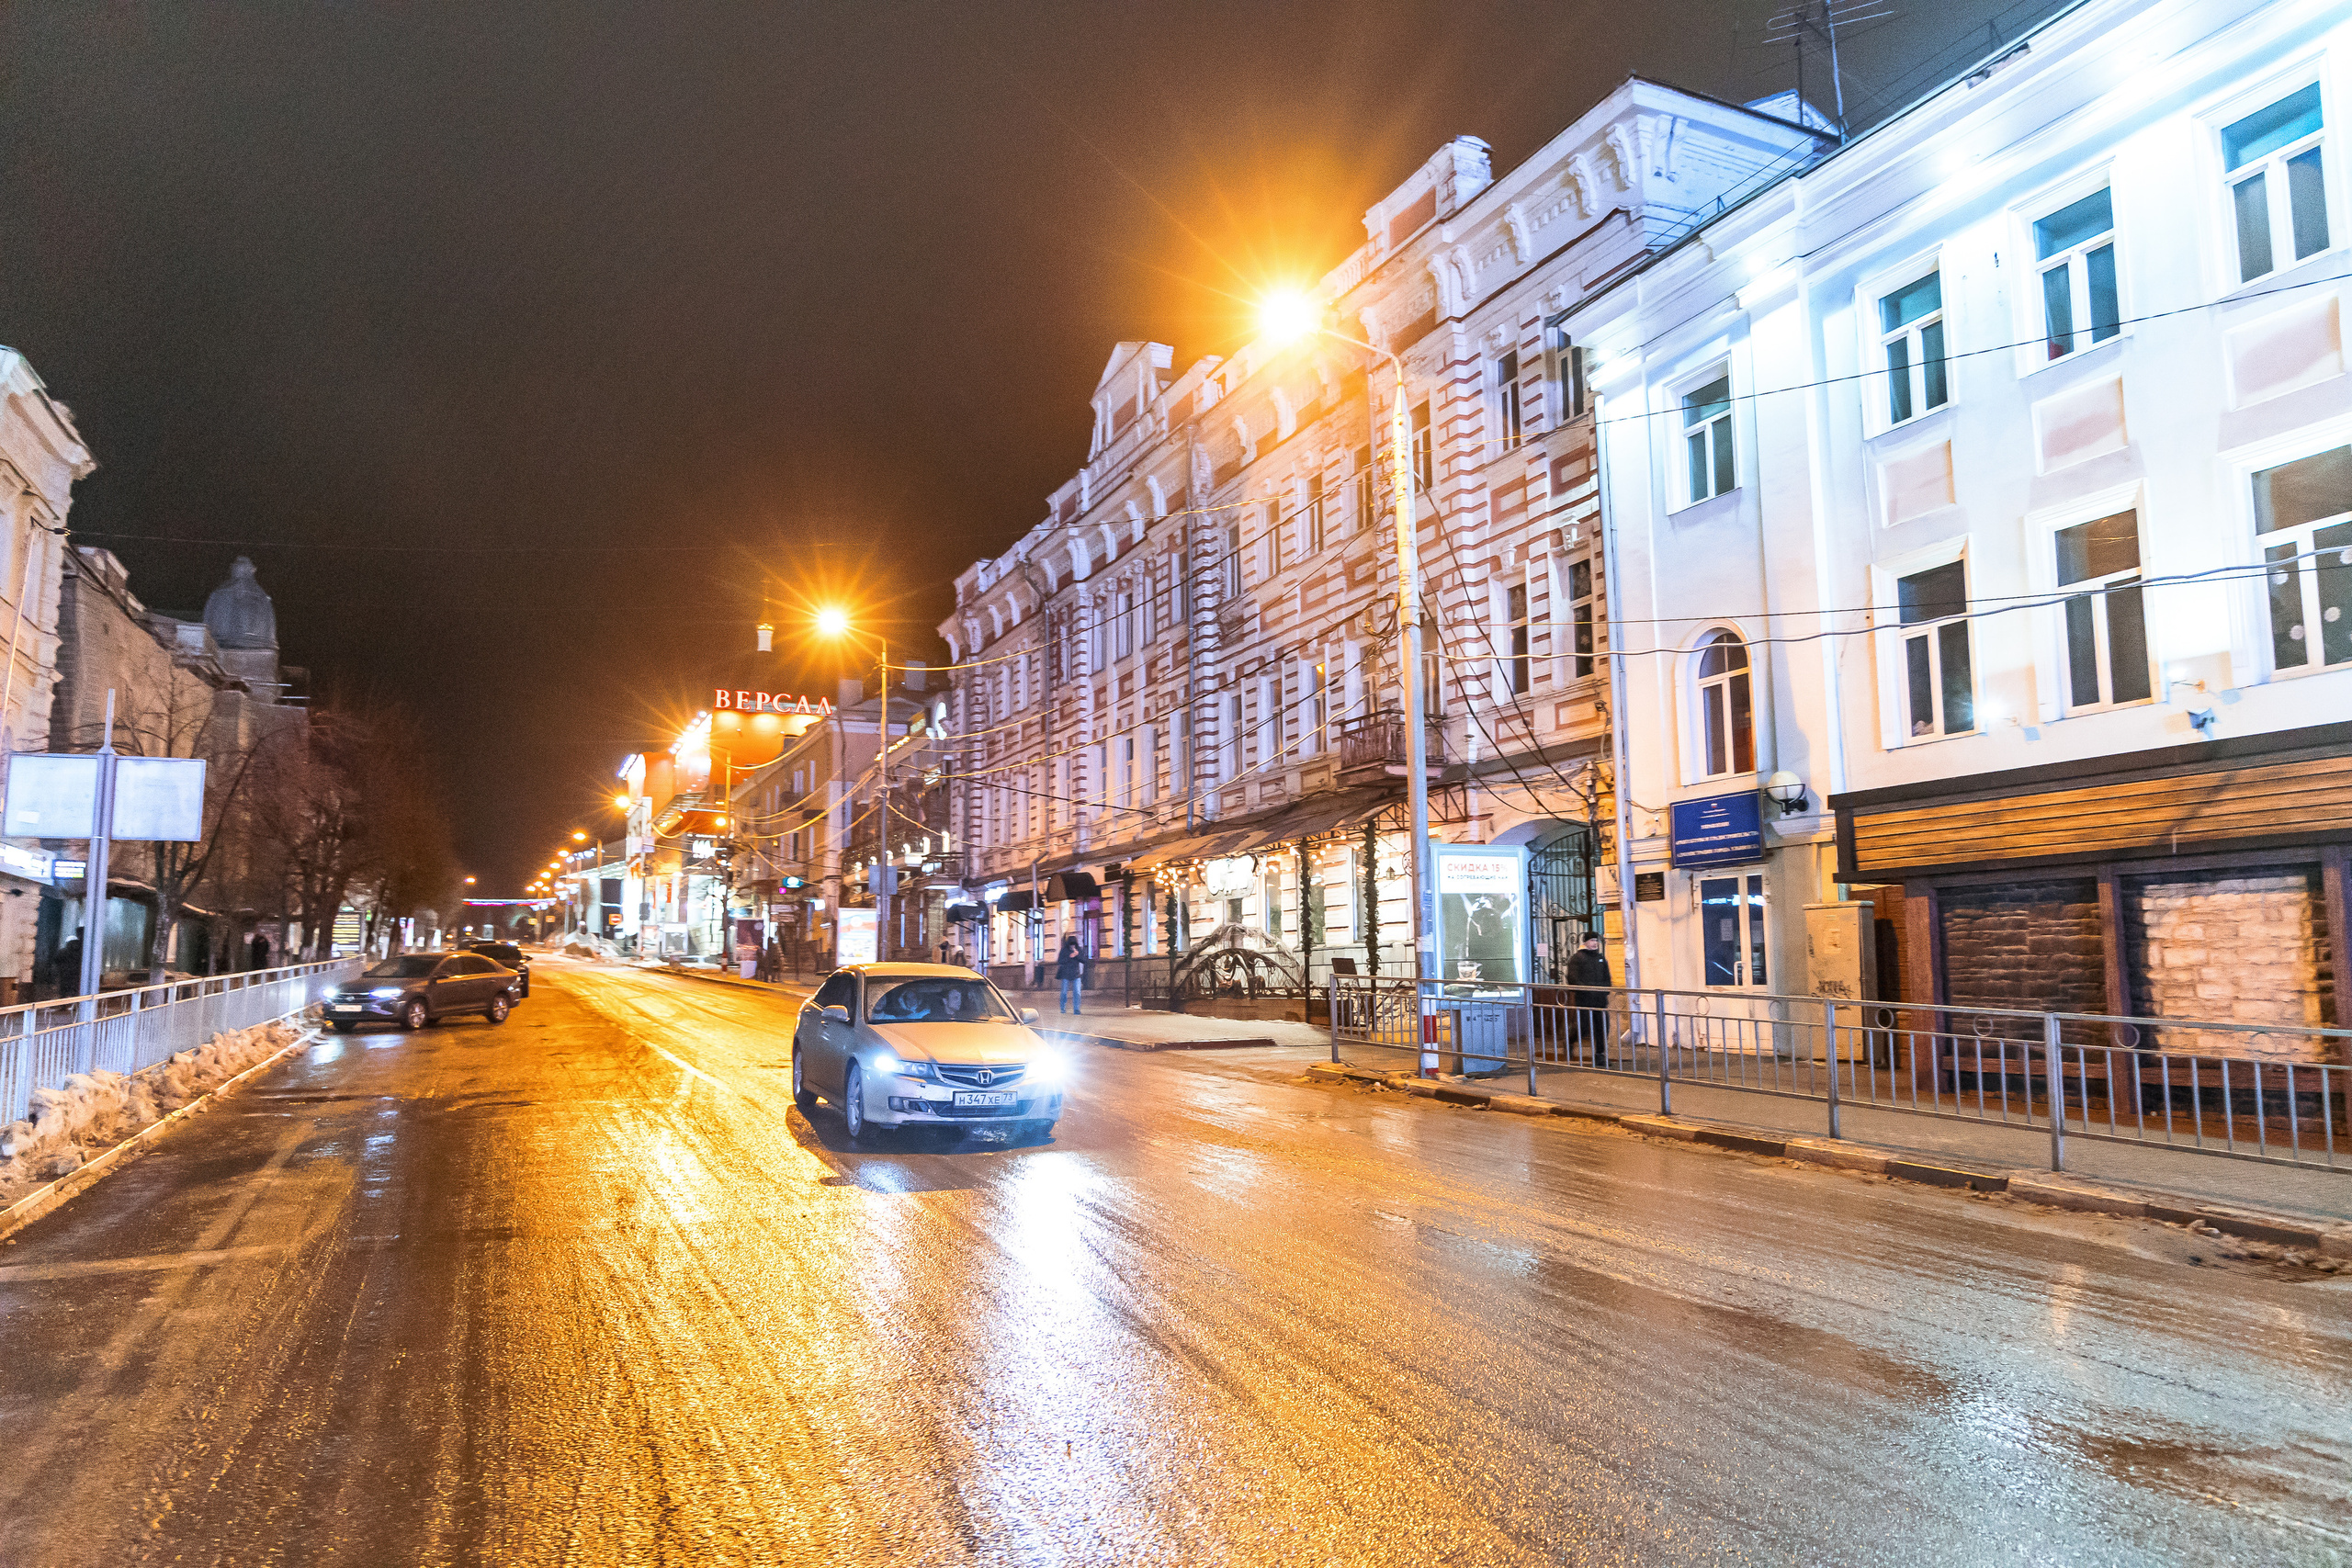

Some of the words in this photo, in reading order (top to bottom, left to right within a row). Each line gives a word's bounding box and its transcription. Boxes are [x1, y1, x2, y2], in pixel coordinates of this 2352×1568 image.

[715, 689, 832, 715] ВЕРСАЛ
[1447, 863, 1488, 873] СКИДКА
[958, 1094, 1001, 1105] Н347ХЕ
[1002, 1093, 1013, 1101] 73
